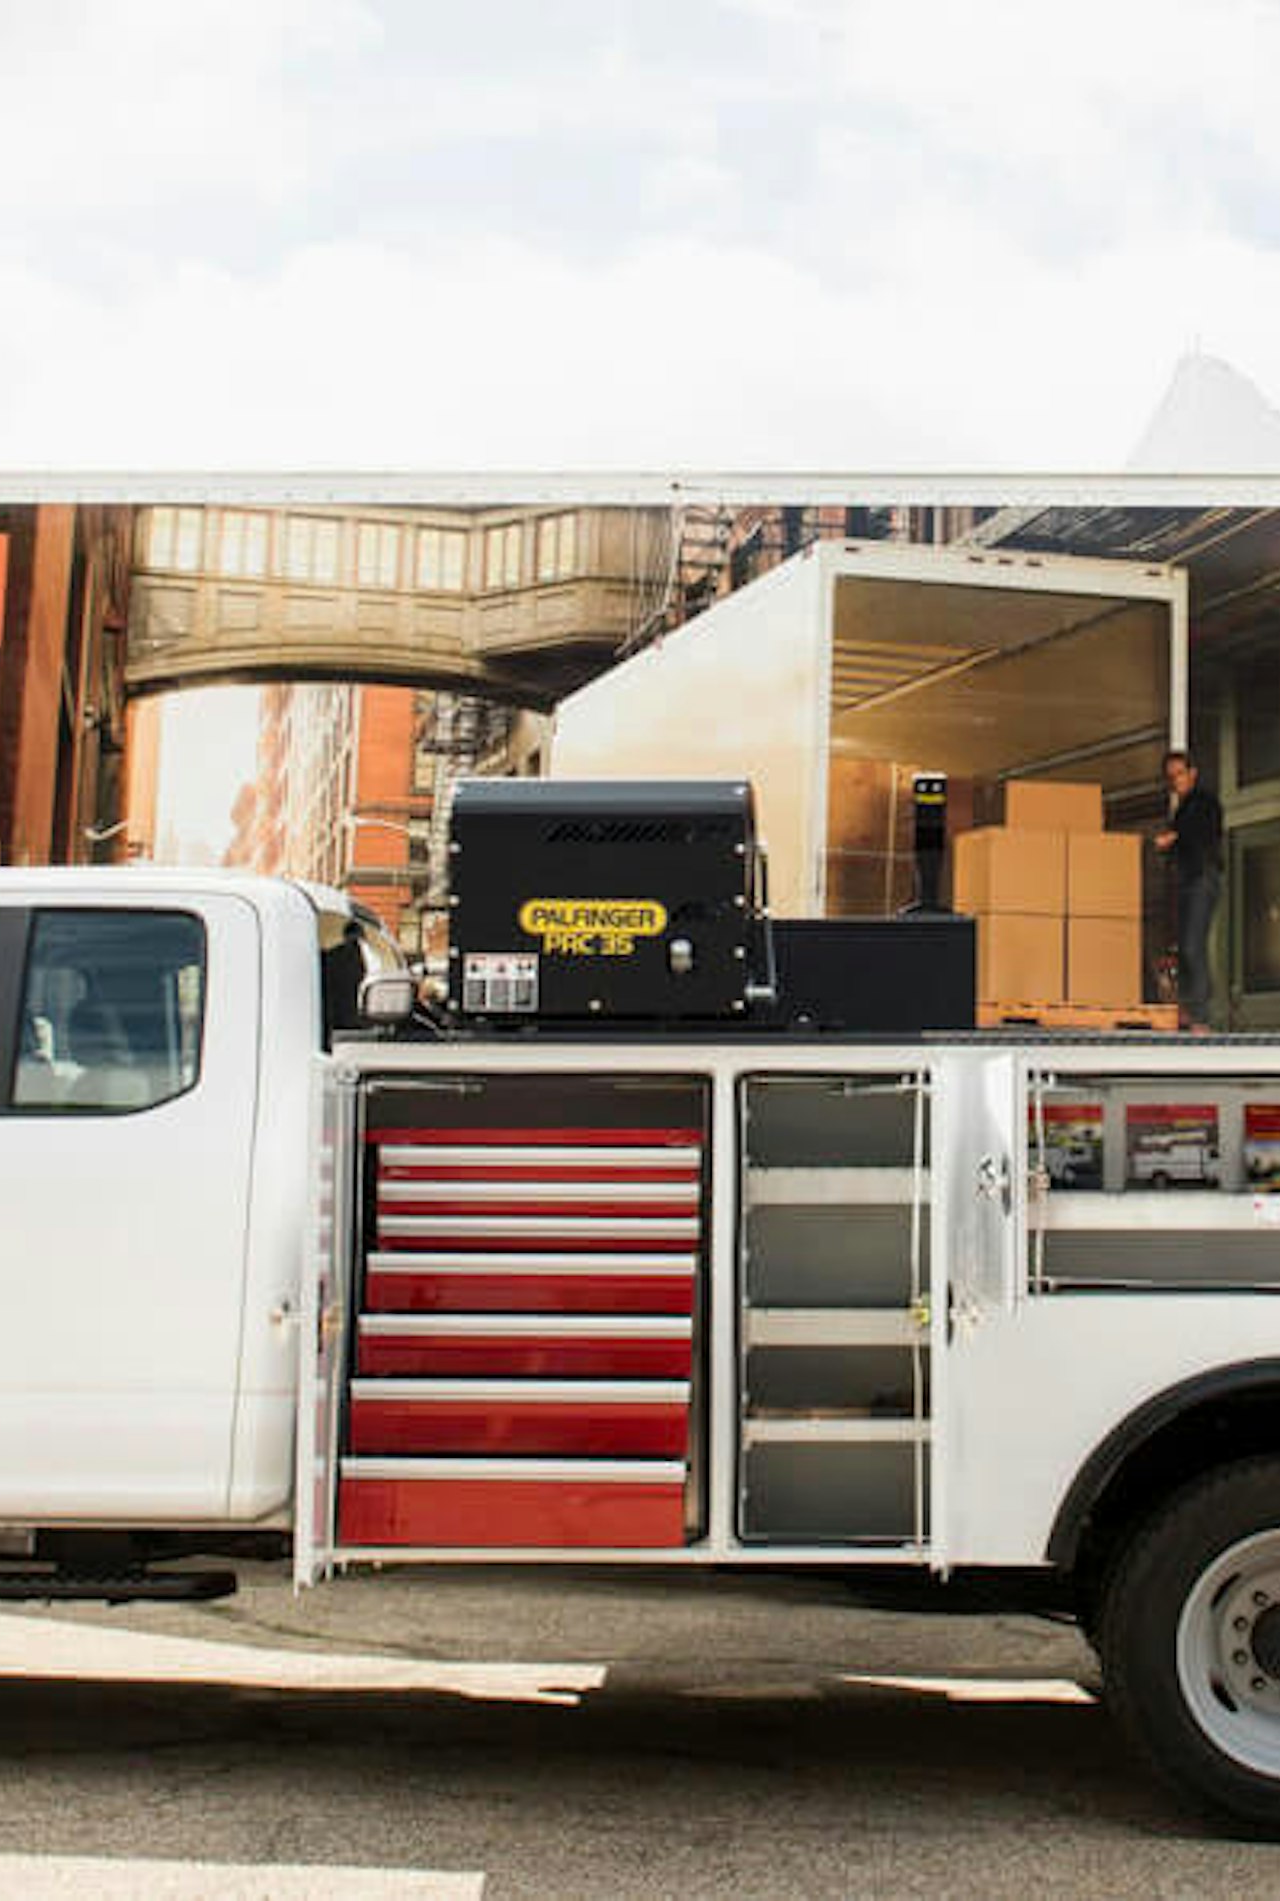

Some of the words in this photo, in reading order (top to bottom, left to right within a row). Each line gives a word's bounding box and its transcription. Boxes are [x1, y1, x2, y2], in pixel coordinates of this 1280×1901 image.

[532, 907, 656, 929] PALFINGER
[543, 934, 595, 956] PRC
[599, 934, 636, 956] 35
